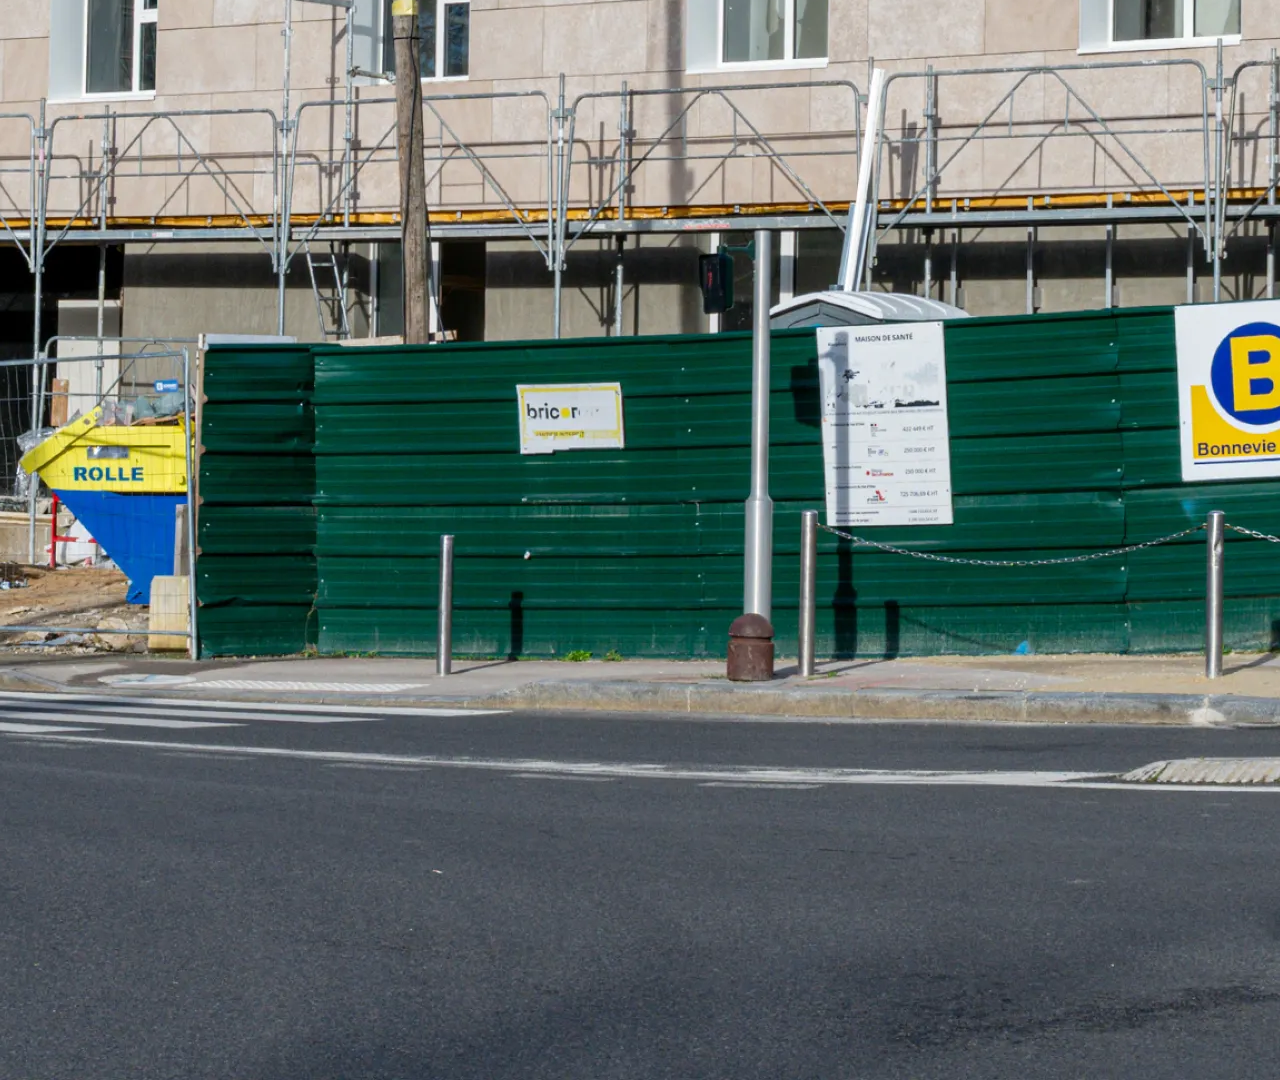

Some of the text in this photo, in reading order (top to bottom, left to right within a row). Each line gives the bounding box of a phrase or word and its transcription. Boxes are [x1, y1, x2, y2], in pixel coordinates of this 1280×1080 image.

[855, 332, 914, 343] MAISON DE SANTÉ
[1197, 439, 1277, 456] Bonnevie
[73, 466, 144, 481] ROLLE
